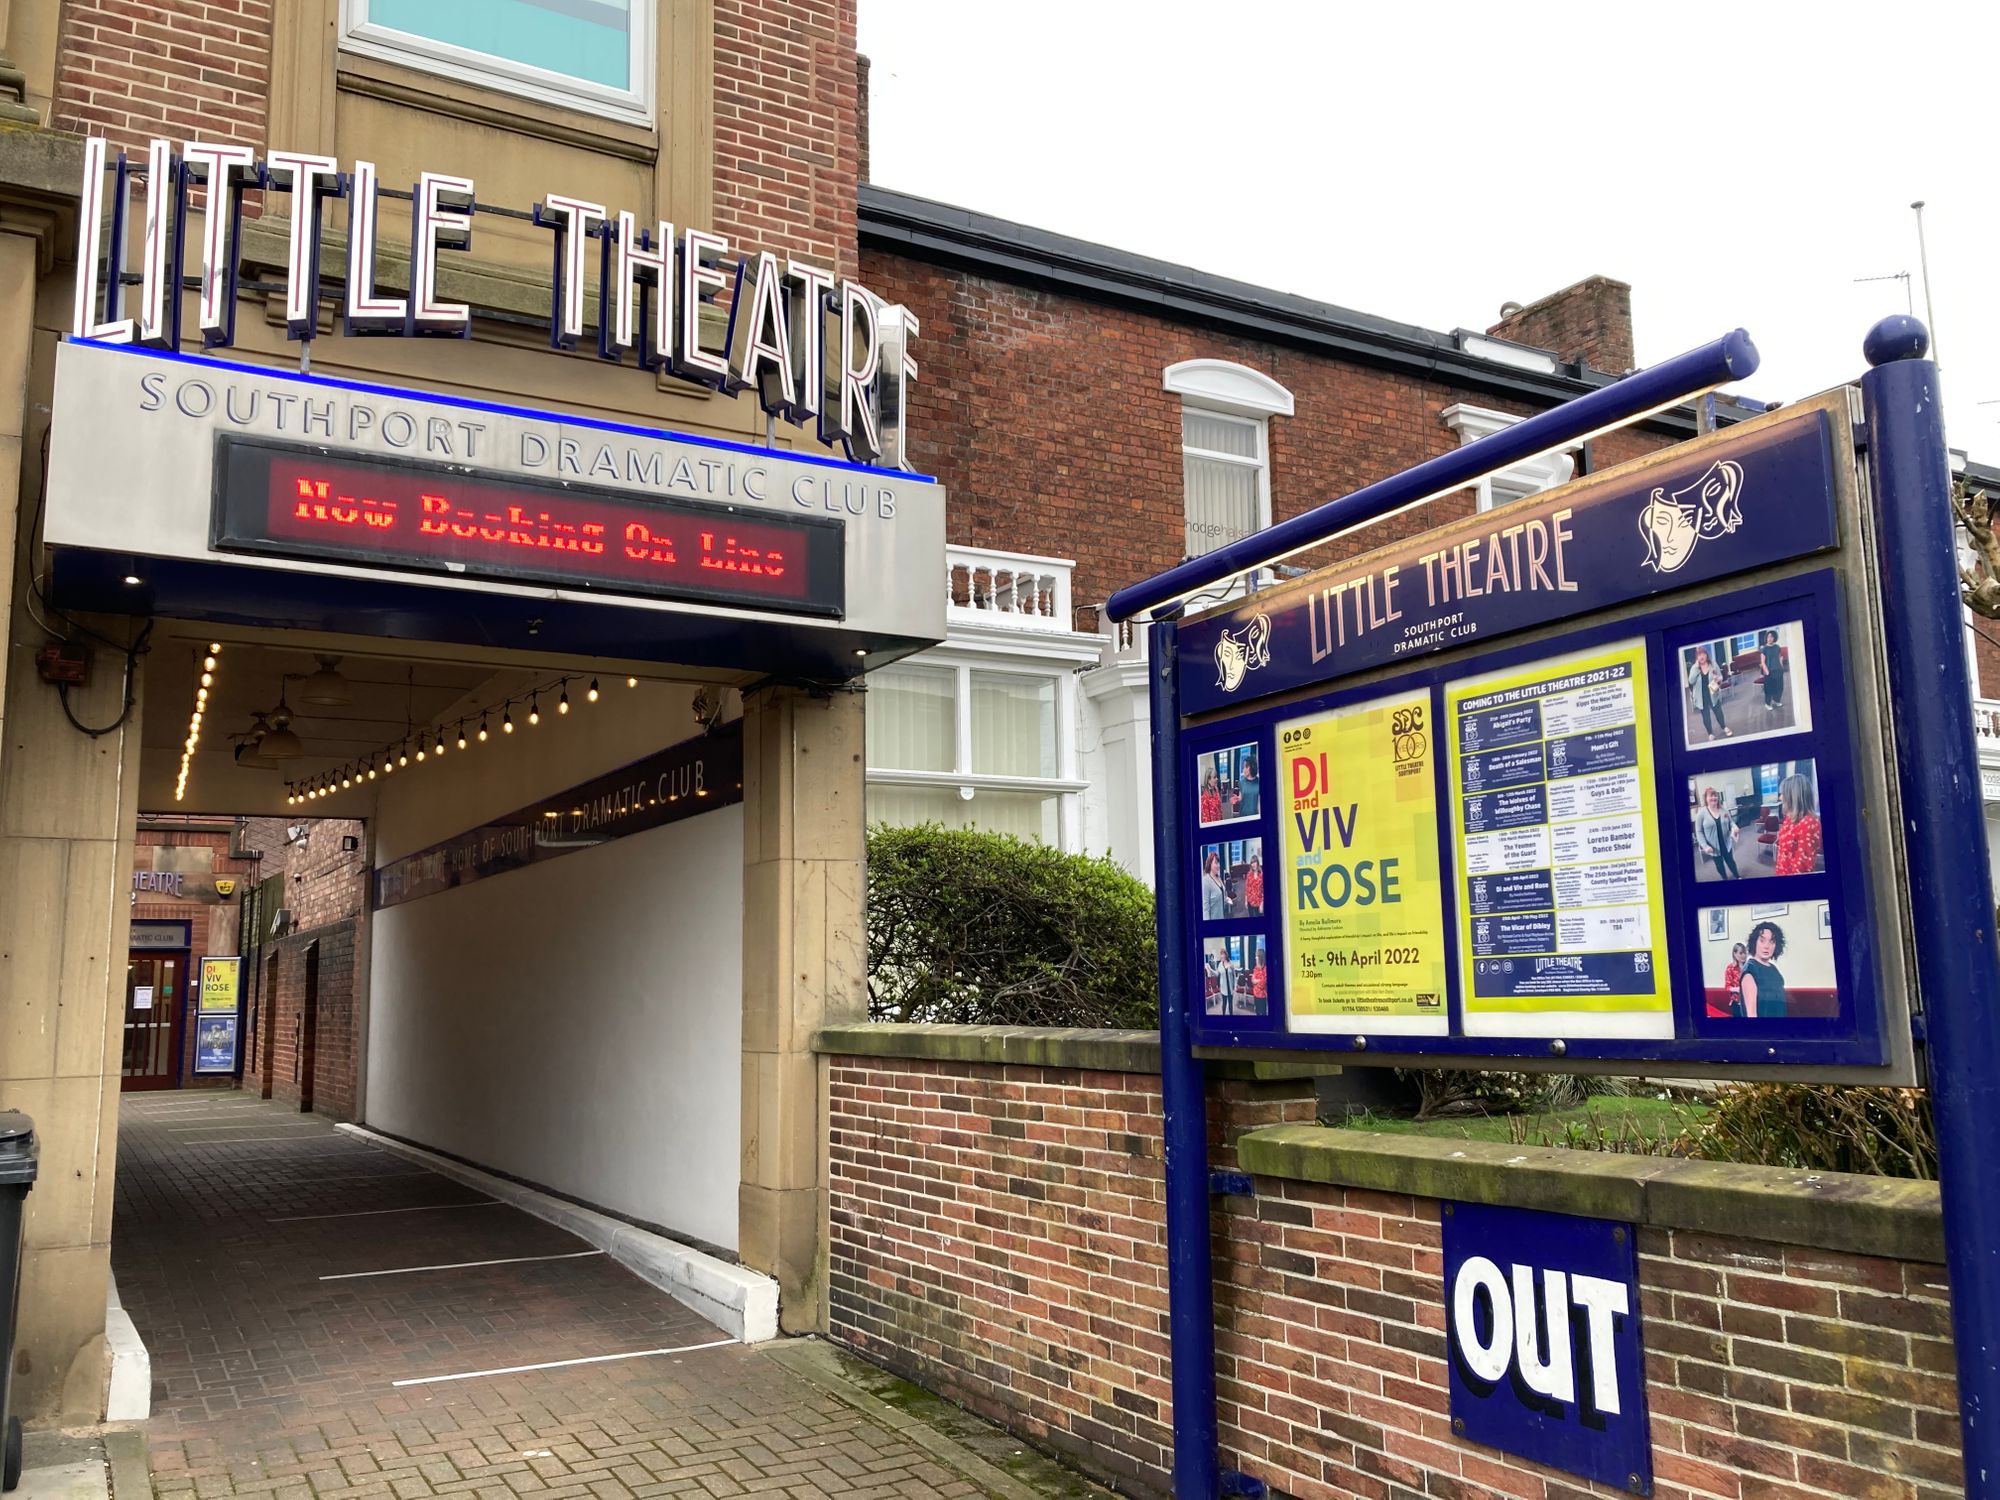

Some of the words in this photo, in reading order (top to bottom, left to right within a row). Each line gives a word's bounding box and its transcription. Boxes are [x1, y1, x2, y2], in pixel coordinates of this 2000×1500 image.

[73, 137, 475, 348] LITTLE
[542, 193, 919, 473] THEATRE
[140, 372, 485, 458] SOUTHPORT
[521, 432, 768, 500] DRAMATIC
[792, 475, 897, 519] CLUB
[295, 477, 397, 528] Now
[420, 494, 604, 554] Booking
[625, 522, 676, 563] On
[700, 532, 785, 577] Line
[1308, 565, 1402, 664] LITTLE
[1418, 508, 1578, 607] THEATRE
[1404, 612, 1464, 638] SOUTHPORT
[1394, 632, 1444, 653] DRAMATIC
[1451, 622, 1477, 638] CLUB
[1463, 696, 1493, 711] COMING
[1493, 694, 1504, 704] TO
[1504, 690, 1521, 702] THE
[1521, 684, 1547, 698] LITTLE
[1547, 675, 1586, 692] THEATRE
[1587, 666, 1625, 684] 2021-22
[1516, 716, 1532, 725] Party
[1489, 762, 1504, 770] Death
[1516, 756, 1542, 766] Salesman
[1292, 752, 1328, 799] DI
[1294, 790, 1319, 811] and
[1591, 790, 1605, 798] Guys
[1611, 786, 1625, 794] Dolls
[452, 844, 477, 872] HOME
[482, 838, 496, 863] OF
[501, 811, 565, 857] SOUTHPORT
[573, 780, 647, 834] DRAMATIC
[658, 759, 705, 804] CLUB
[1295, 803, 1358, 852] VIV
[1587, 834, 1609, 844] Loreto
[1610, 832, 1635, 842] Bamber
[1296, 847, 1321, 867] and
[1520, 849, 1537, 857] Guard
[1592, 844, 1612, 853] Dance
[1614, 842, 1632, 851] Show
[1297, 858, 1402, 910] ROSE
[1301, 952, 1316, 968] 1st
[1326, 950, 1347, 967] 9th
[1350, 949, 1381, 969] April
[1385, 947, 1420, 965] 2022
[1535, 957, 1555, 974] LITTLE
[1555, 956, 1583, 972] THEATRE
[206, 965, 216, 974] DI
[206, 974, 222, 982] VIV
[1301, 970, 1323, 979] 7.30pm
[205, 983, 230, 992] ROSE
[1454, 1256, 1629, 1415] OUT
